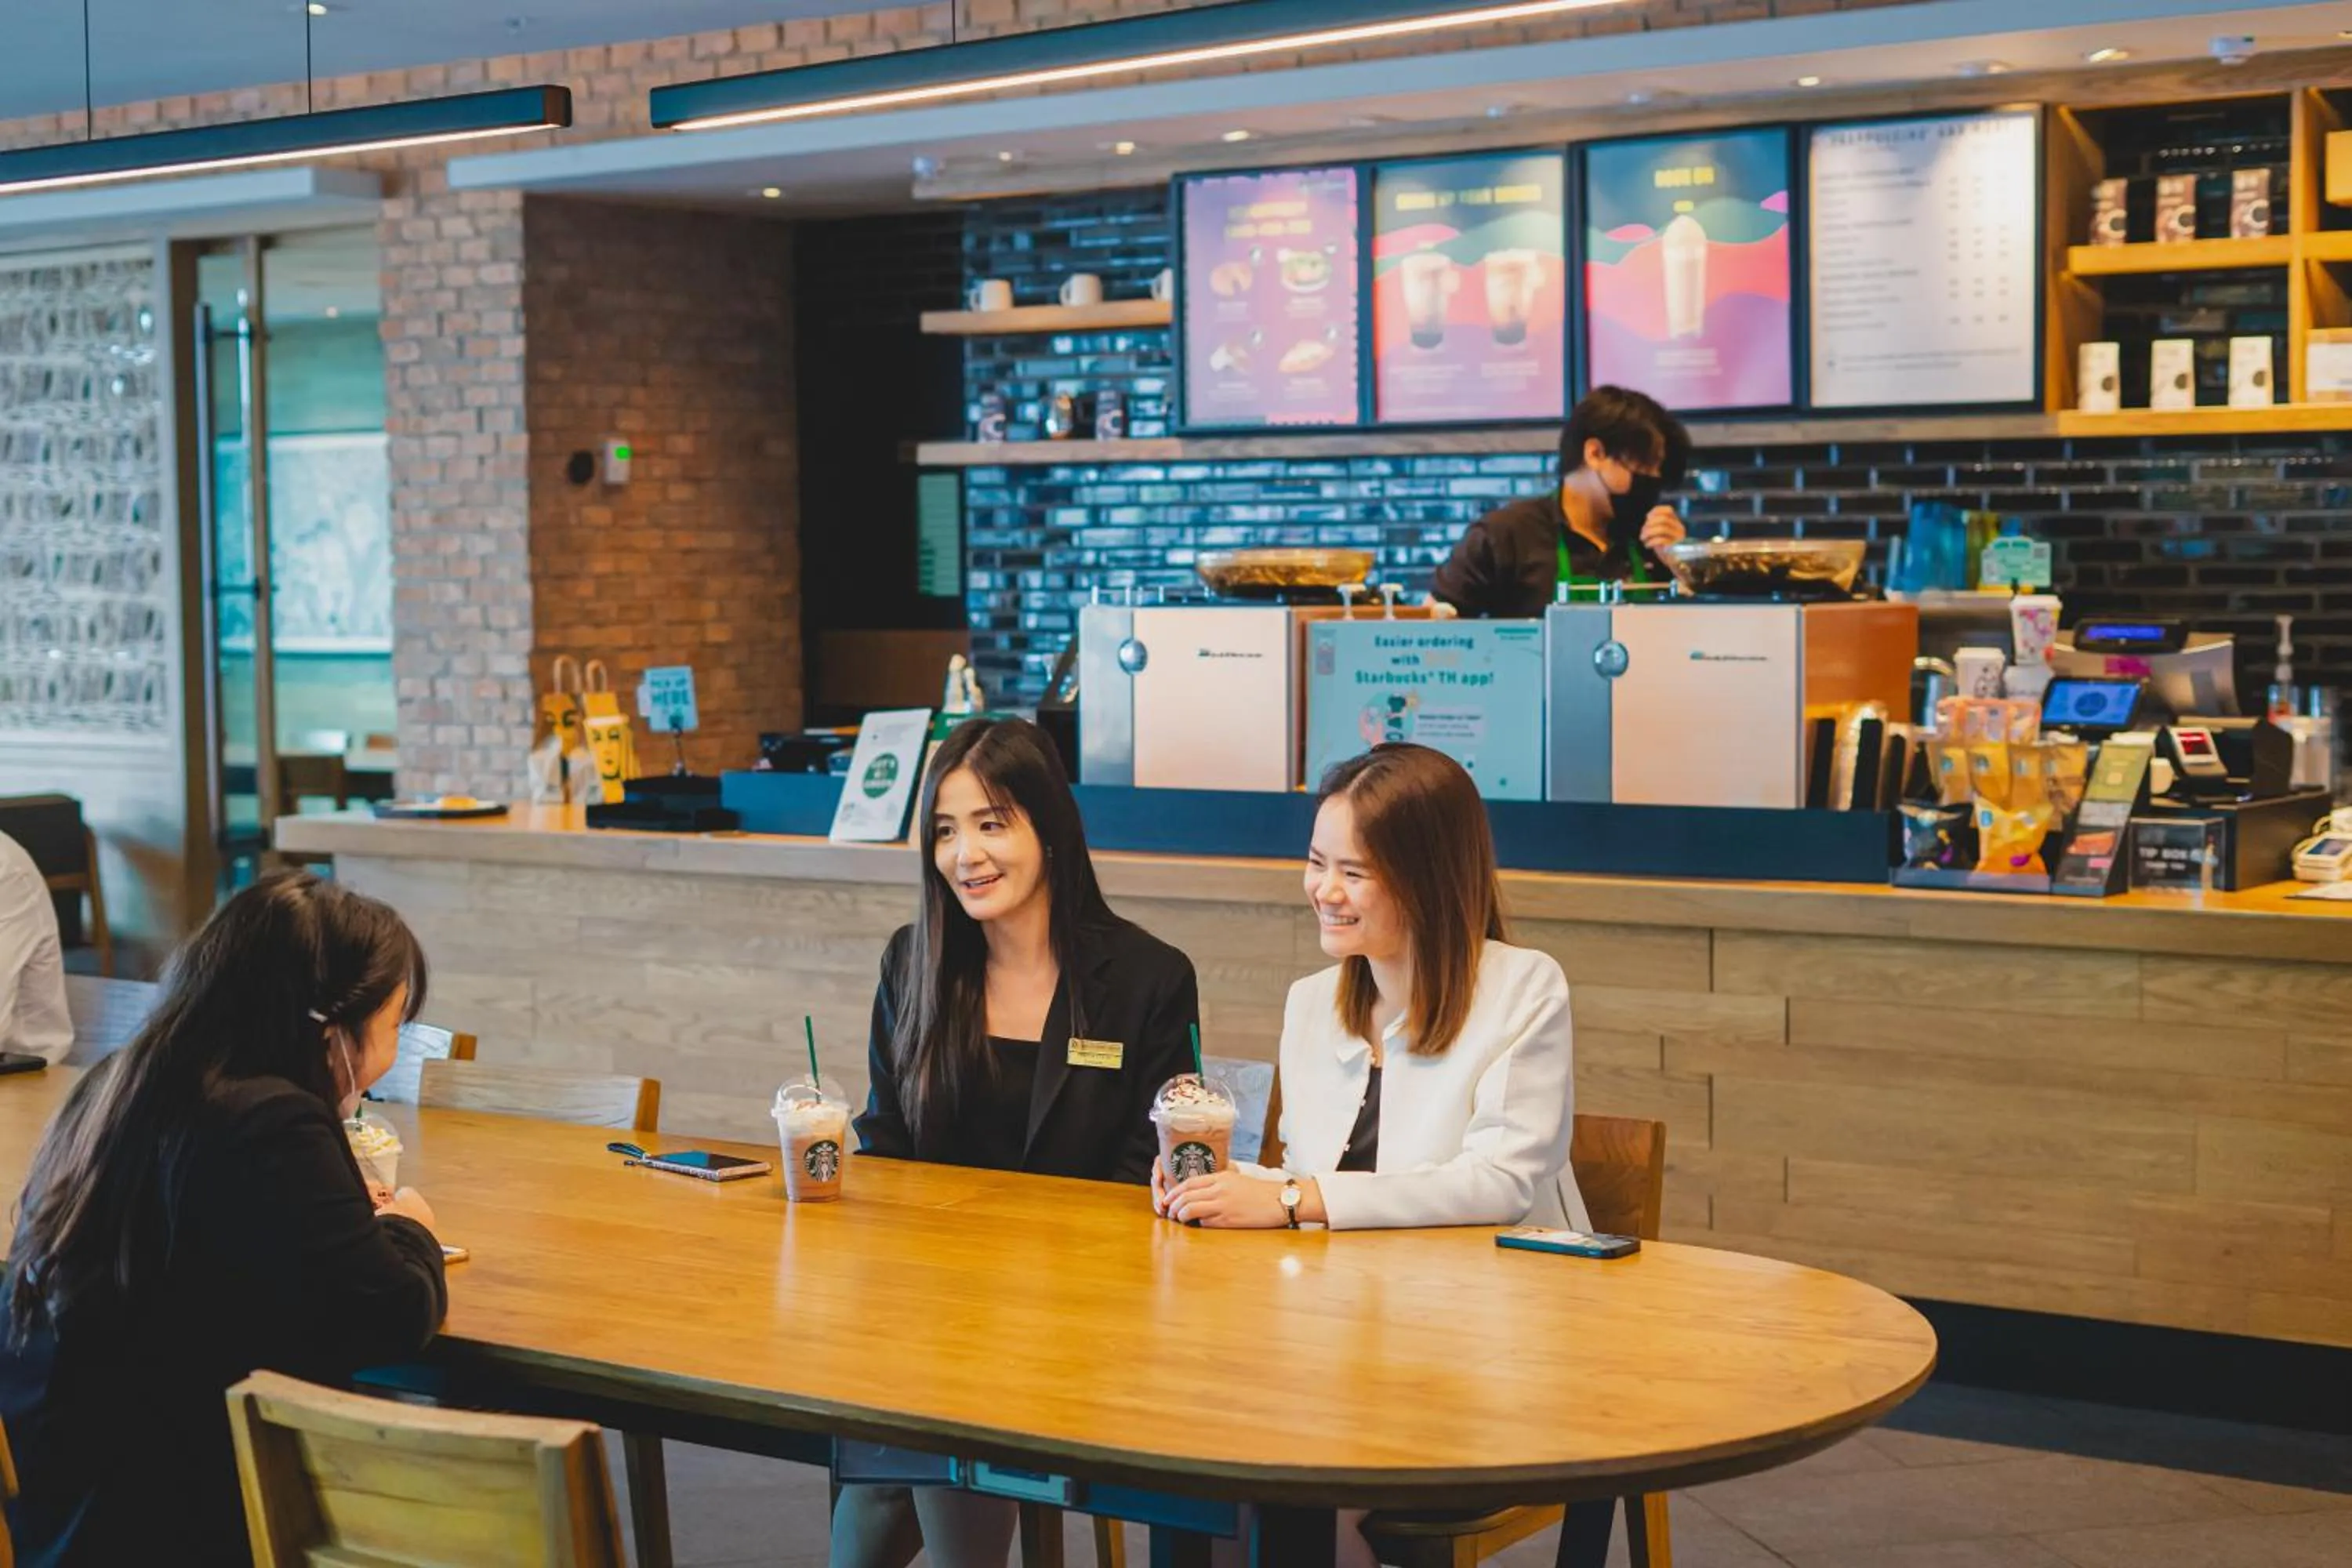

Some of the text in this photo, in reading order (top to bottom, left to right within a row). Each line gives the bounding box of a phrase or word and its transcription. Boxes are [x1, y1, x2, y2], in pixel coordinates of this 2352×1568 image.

[1374, 635, 1474, 650] Easier ordering
[1392, 654, 1420, 665] with
[1439, 671, 1457, 684] TH
